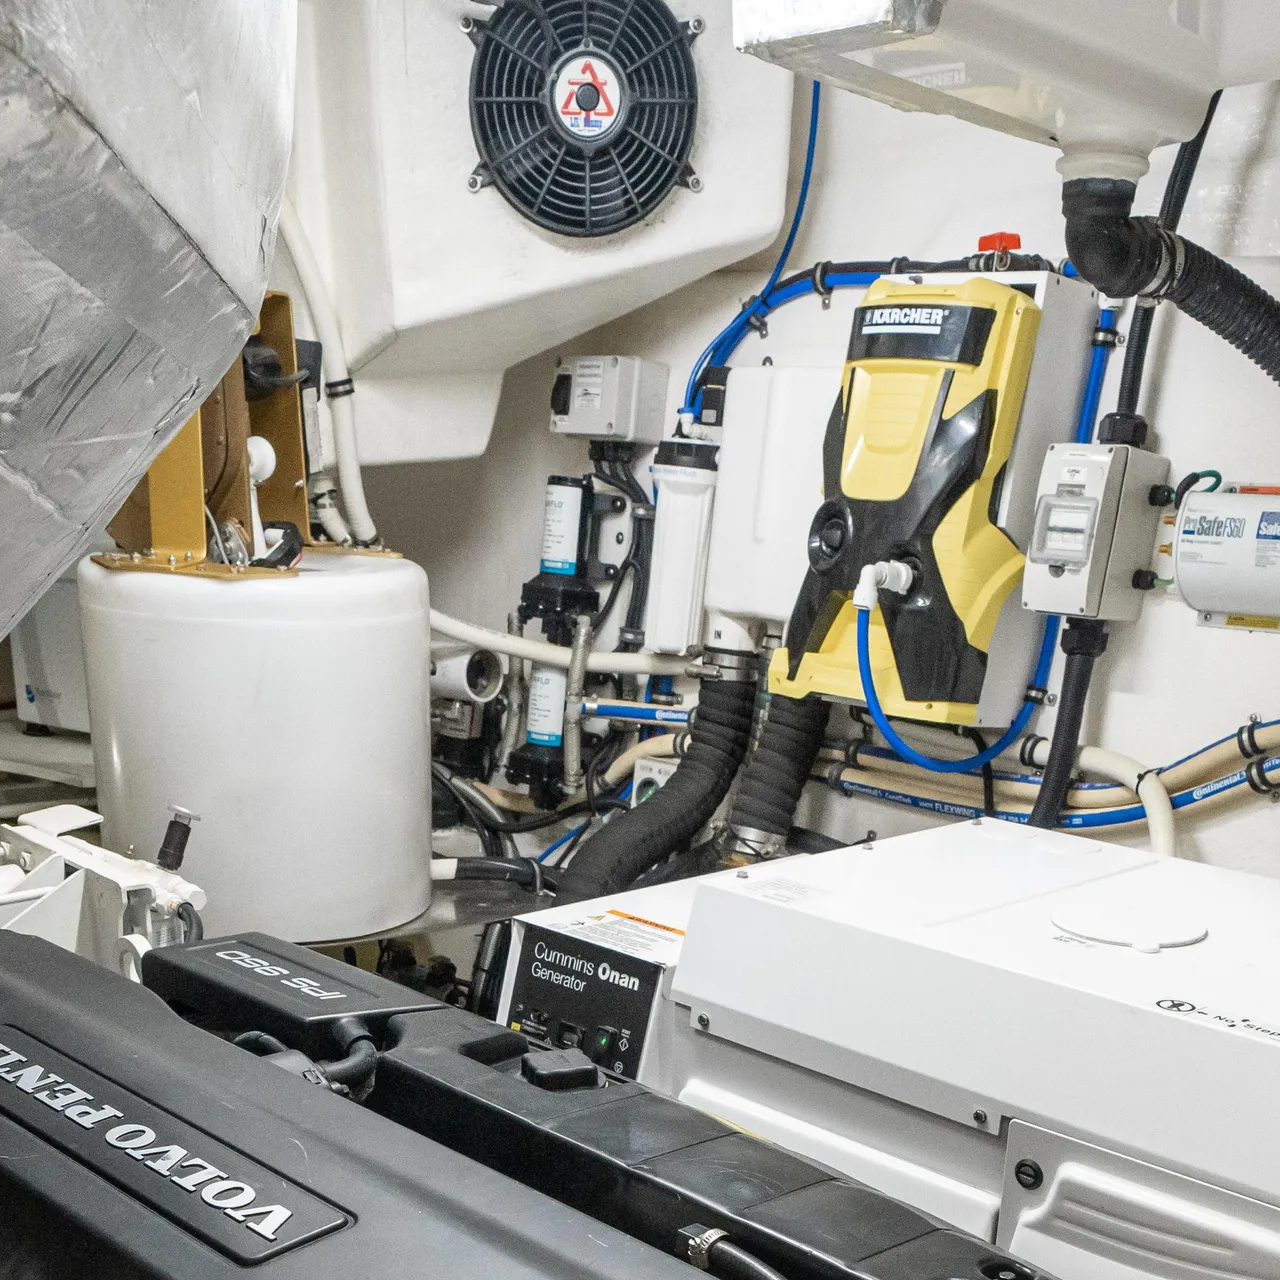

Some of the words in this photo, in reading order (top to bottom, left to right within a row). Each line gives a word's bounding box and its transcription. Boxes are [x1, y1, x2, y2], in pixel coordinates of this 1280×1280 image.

[1192, 772, 1241, 800] Continental
[934, 803, 976, 818] FLEXWING
[531, 962, 587, 992] Generator
[534, 942, 595, 976] Cummins
[597, 962, 640, 991] Onan
[105, 1123, 295, 1242] VOLVO
